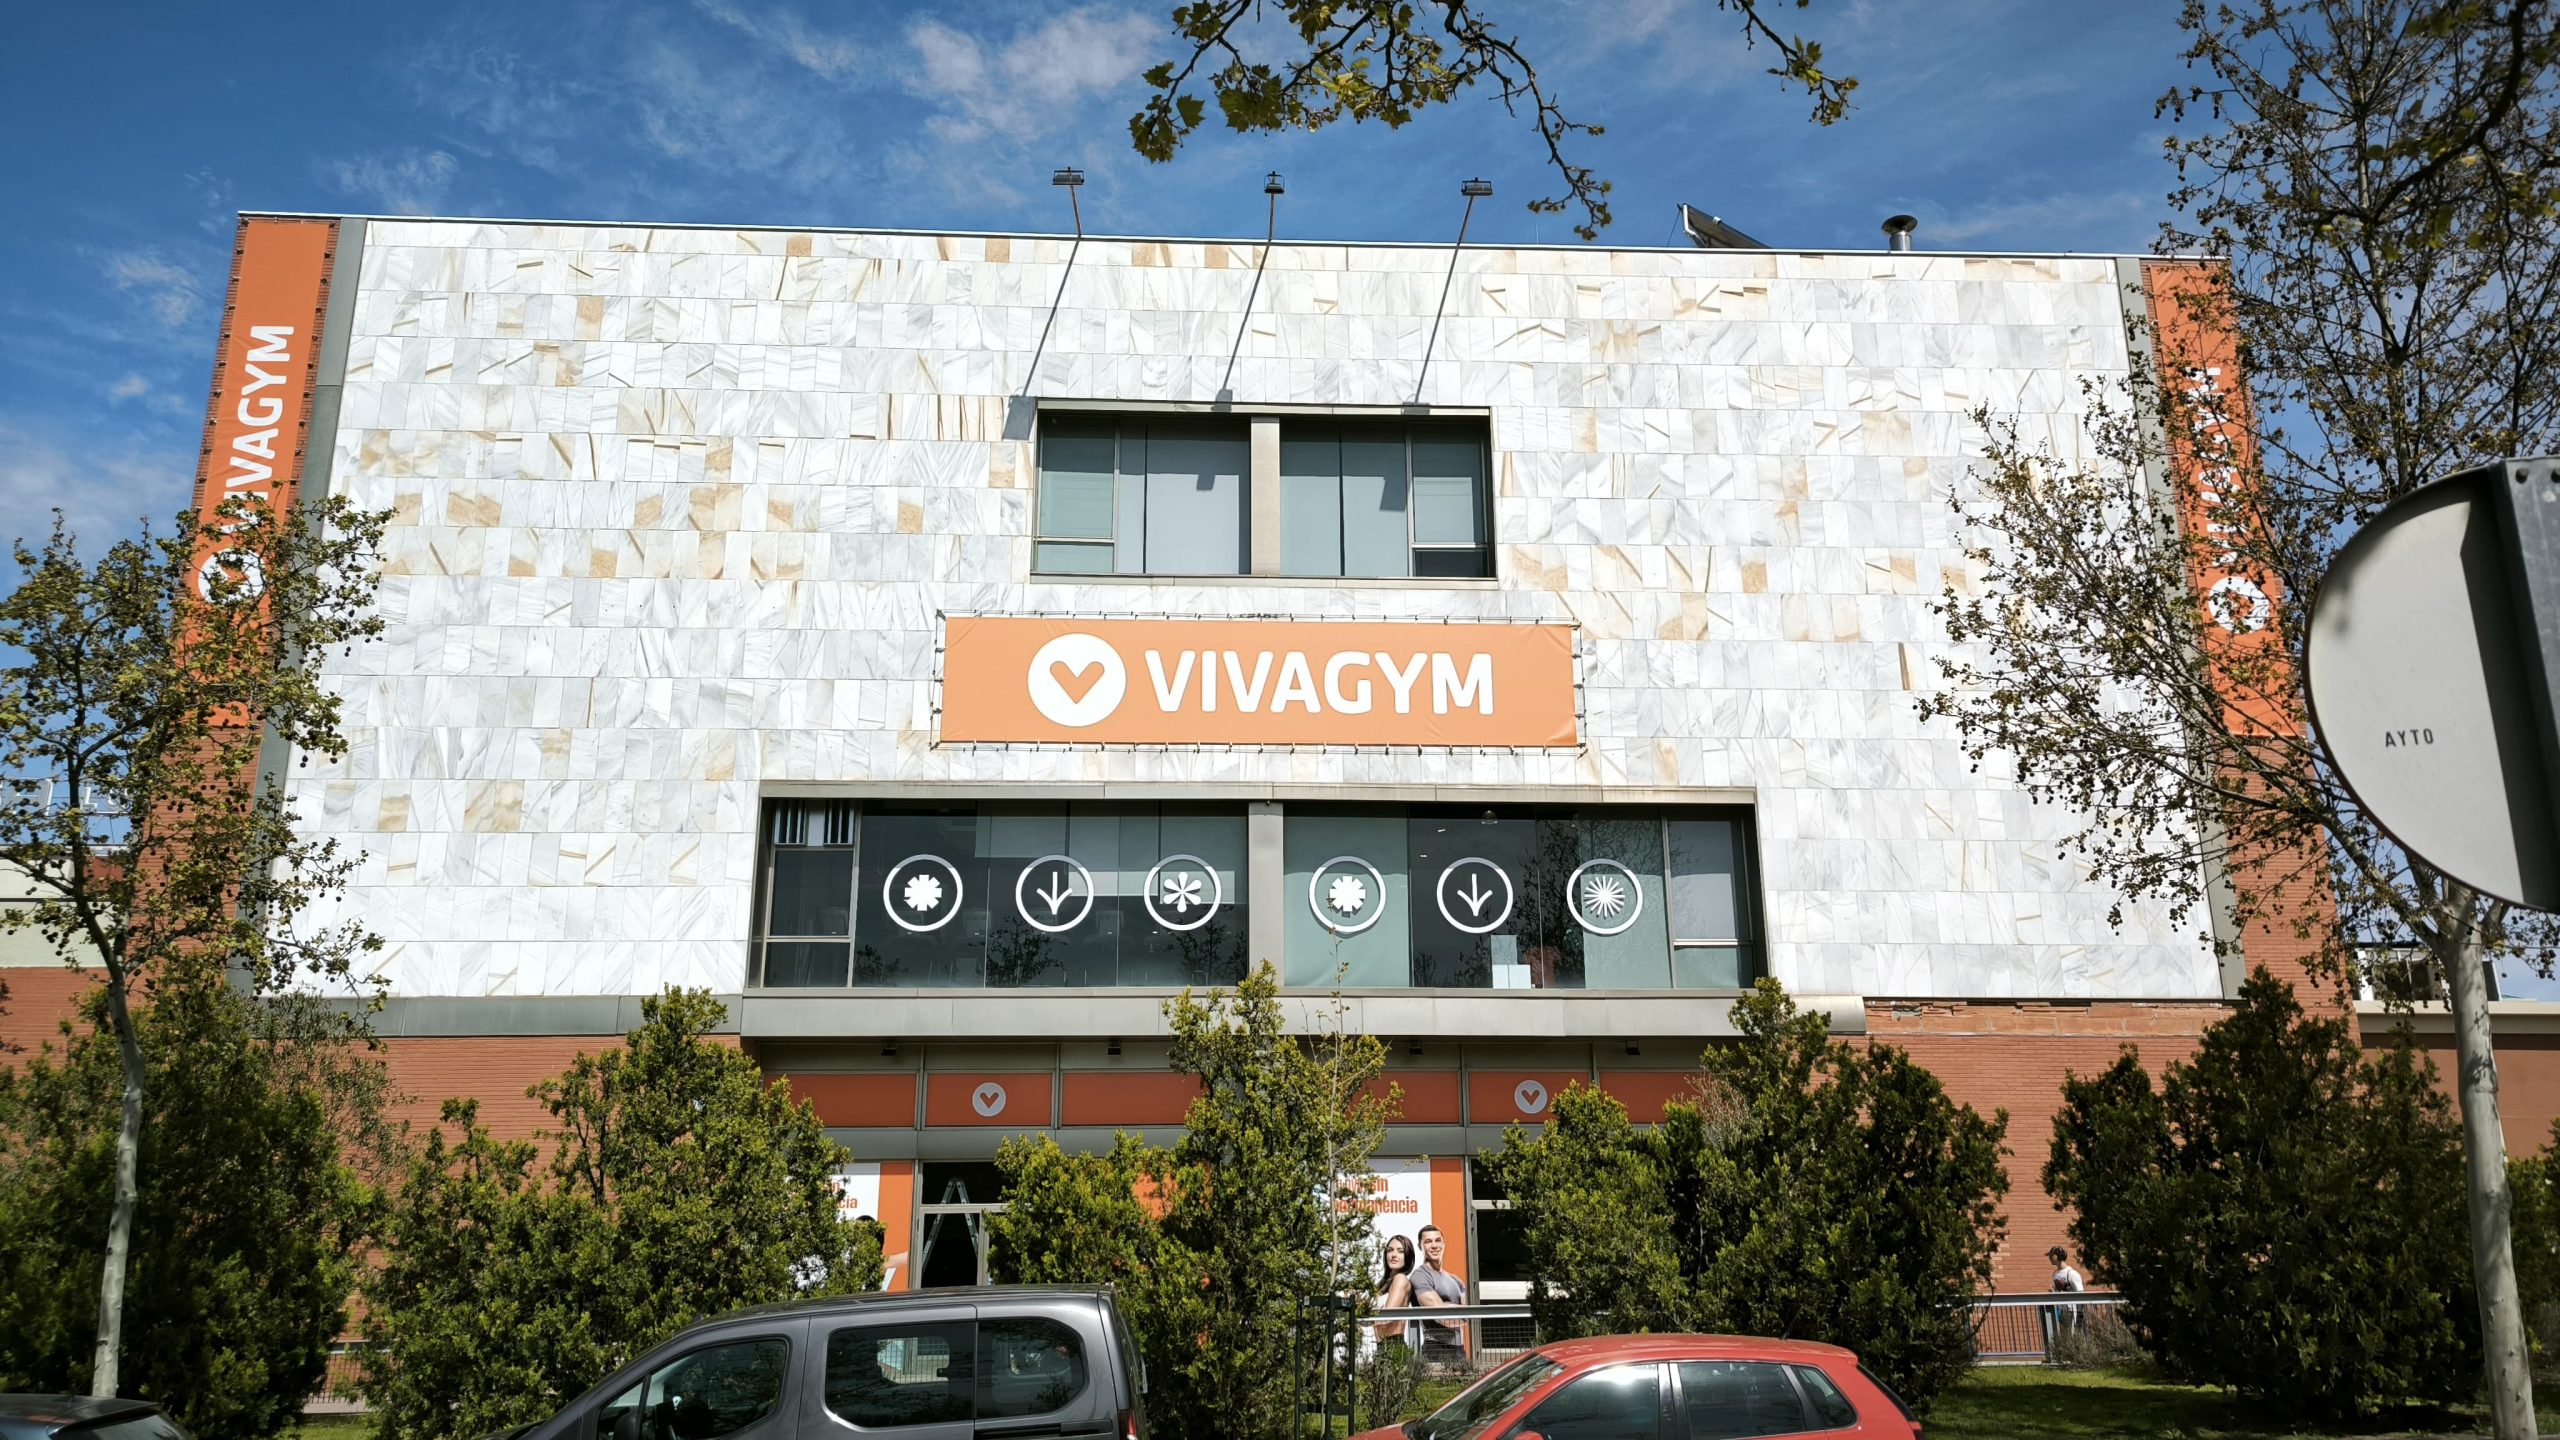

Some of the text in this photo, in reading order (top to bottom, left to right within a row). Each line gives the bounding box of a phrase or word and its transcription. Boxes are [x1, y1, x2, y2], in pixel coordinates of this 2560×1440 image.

[220, 325, 295, 535] VIVAGYM
[1144, 648, 1494, 716] VIVAGYM
[2385, 728, 2434, 748] AYTO
[1334, 1196, 1418, 1213] pemanencia
